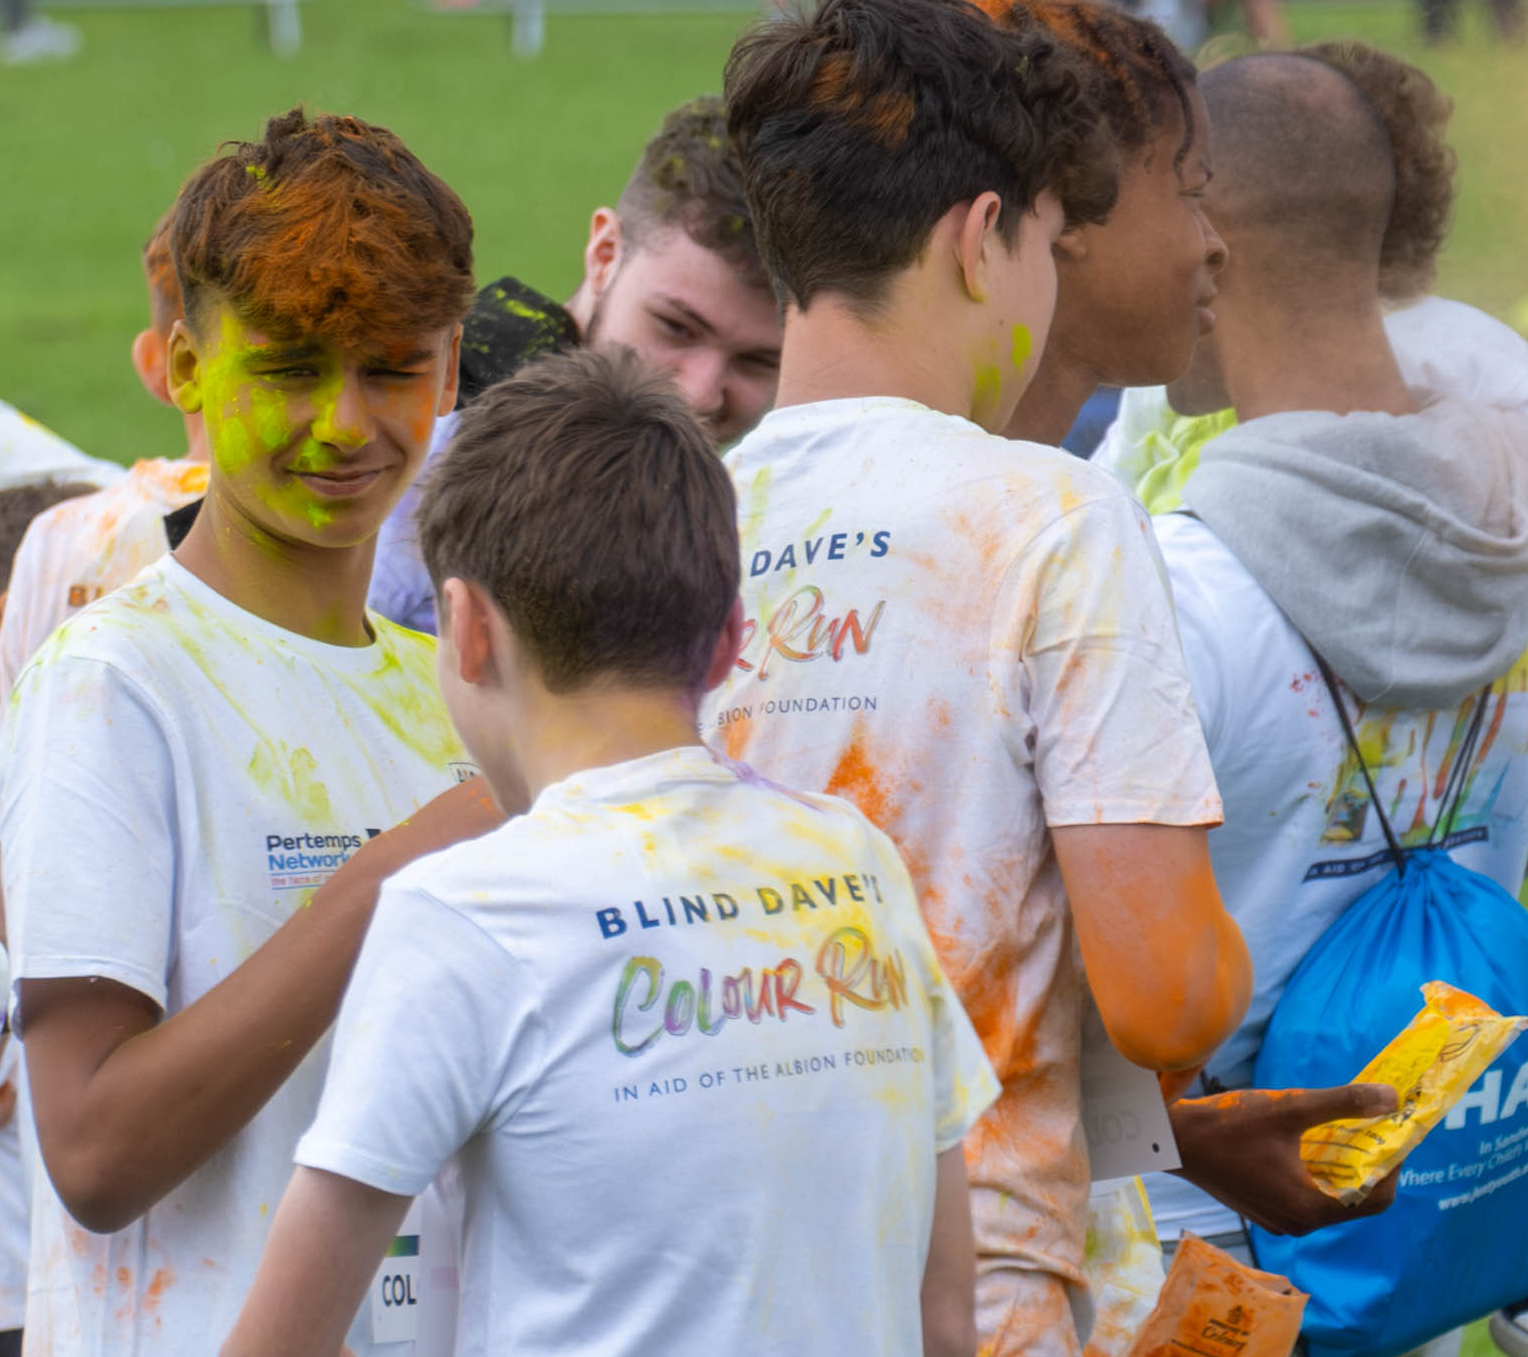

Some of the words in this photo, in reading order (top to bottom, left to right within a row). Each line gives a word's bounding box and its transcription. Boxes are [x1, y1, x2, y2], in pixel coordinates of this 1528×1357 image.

[750, 530, 892, 577] DAVE'S
[758, 695, 879, 716] OUNDATION
[266, 832, 363, 852] Pertemps
[595, 892, 740, 940] BLIND
[614, 1087, 638, 1103] IN
[649, 1077, 688, 1097] AID
[698, 1070, 726, 1089] OF
[733, 1063, 770, 1084] THE
[775, 1055, 836, 1078] ALBION
[1479, 1141, 1492, 1155] In
[1448, 1160, 1486, 1181] Every
[382, 1273, 418, 1308] COL
